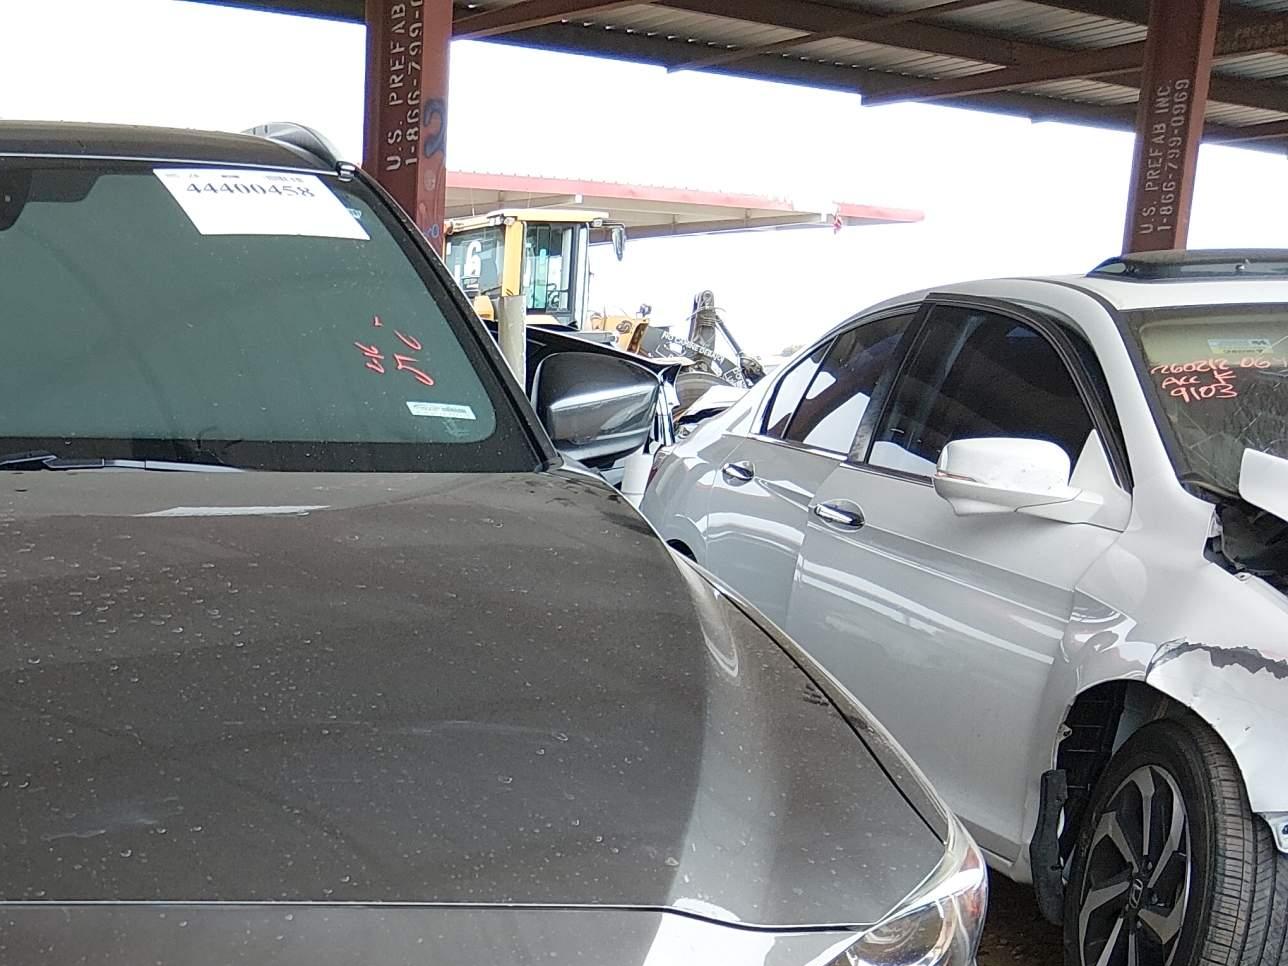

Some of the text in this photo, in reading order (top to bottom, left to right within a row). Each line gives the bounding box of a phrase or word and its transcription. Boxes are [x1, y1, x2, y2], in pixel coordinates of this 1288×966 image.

[386, 2, 406, 171] U.S. PREFAB
[1145, 122, 1167, 191] PREFAB
[1158, 78, 1190, 231] 1-866-799-0969
[187, 182, 315, 197] 44400458
[1140, 200, 1157, 234] U.S.
[1171, 382, 1238, 403] 9103
